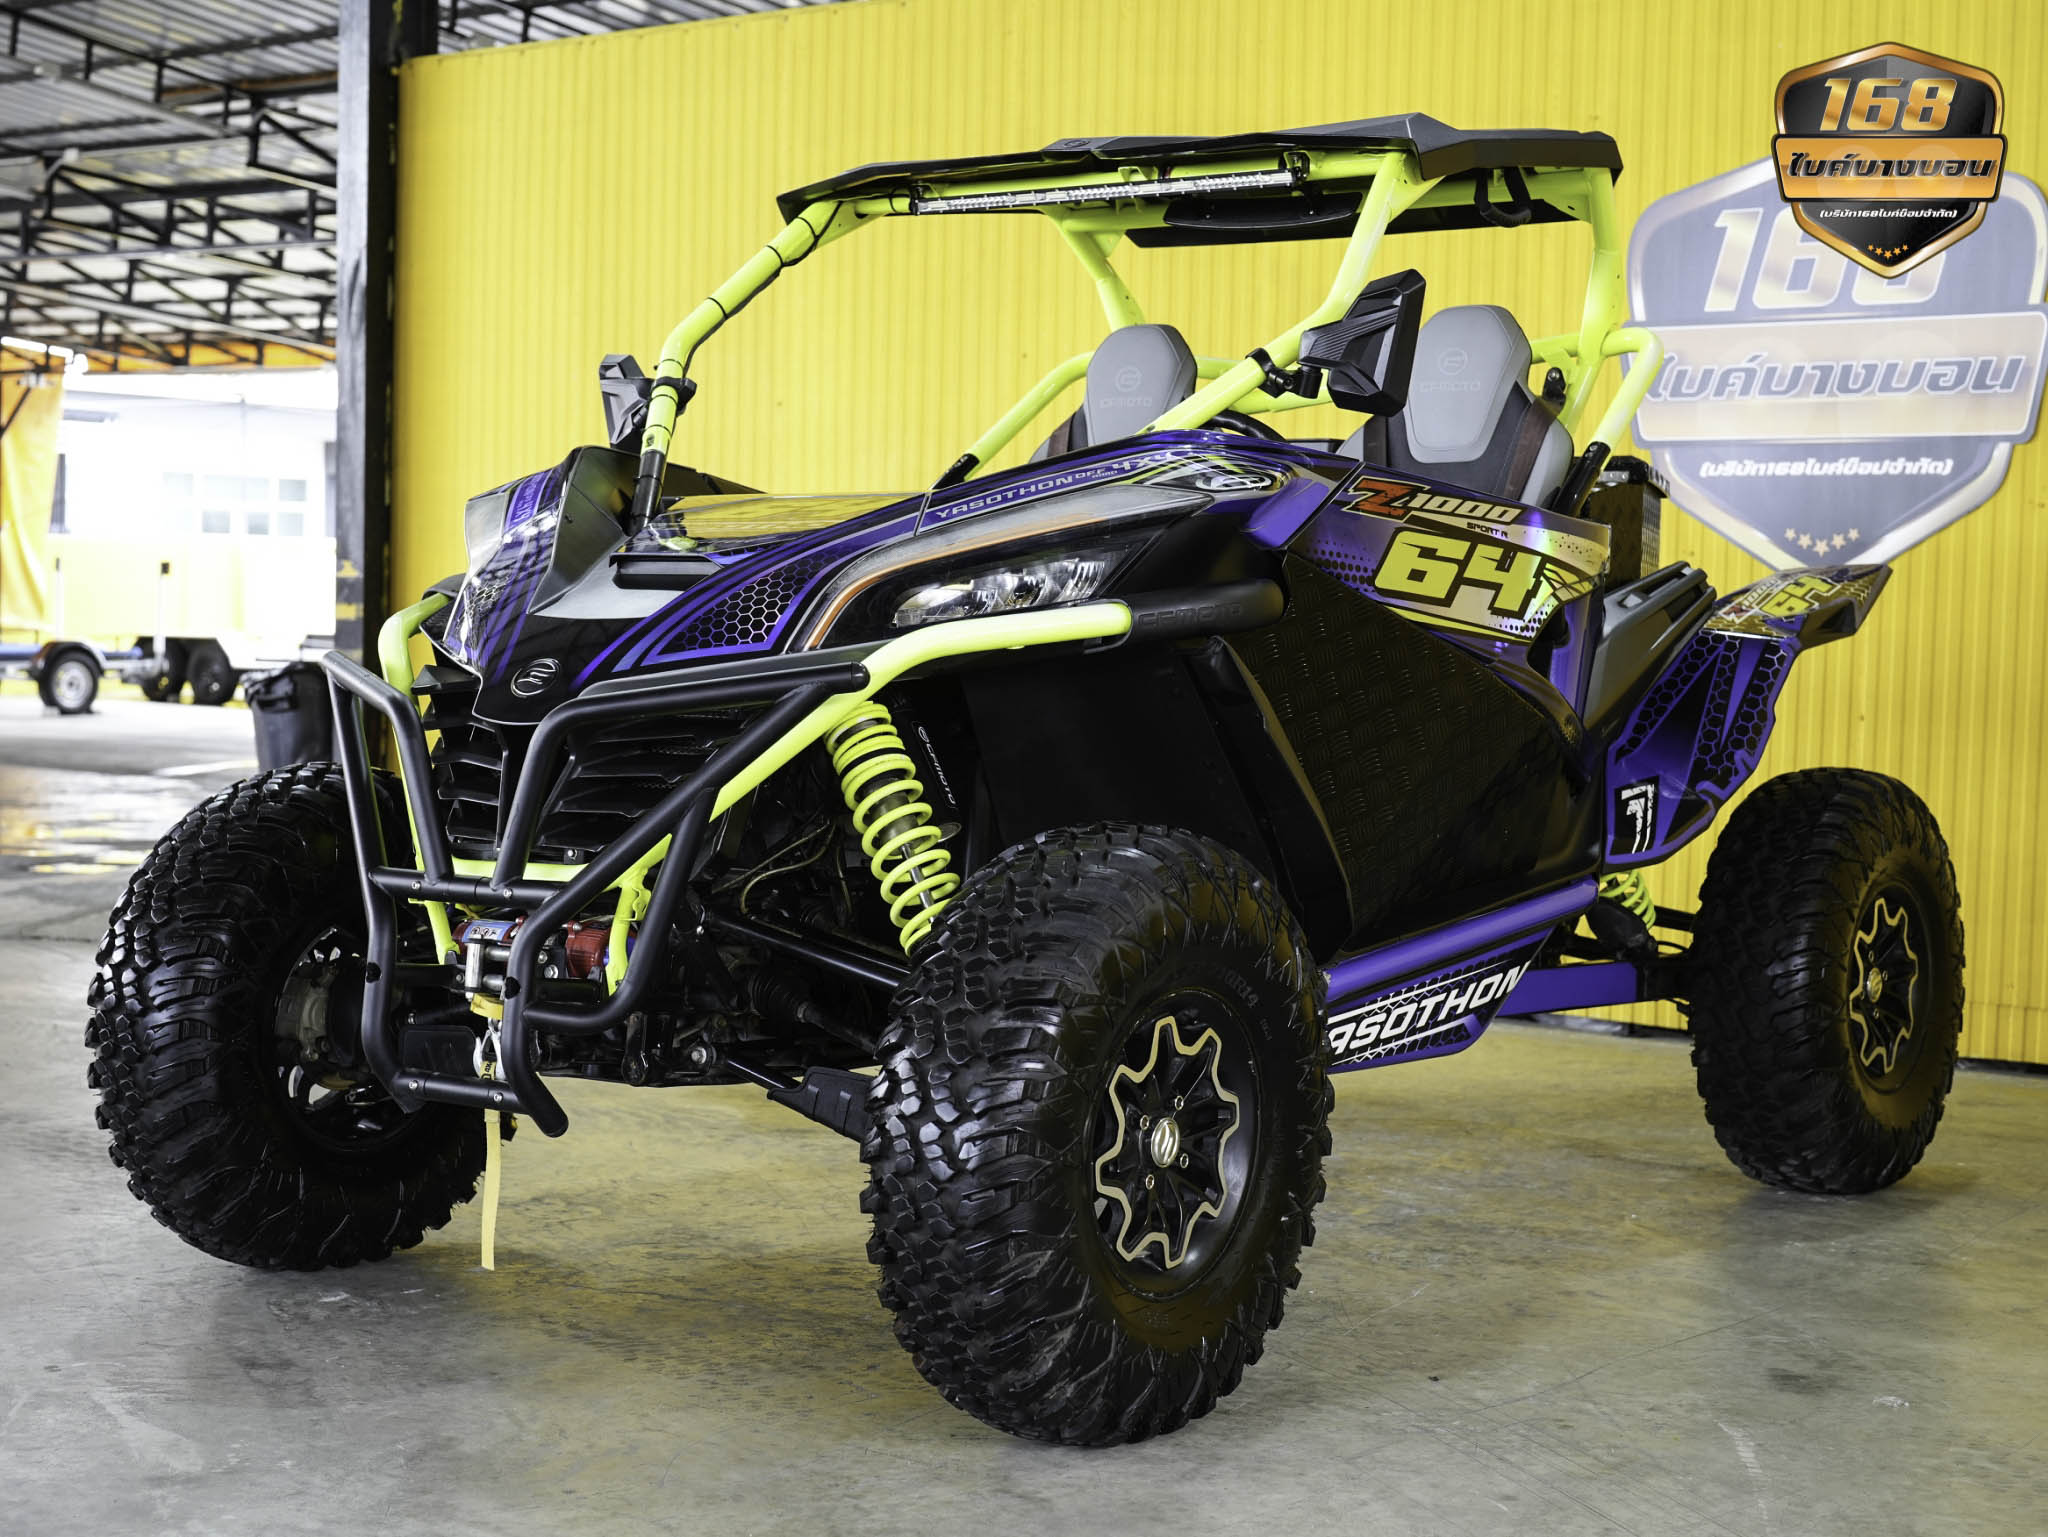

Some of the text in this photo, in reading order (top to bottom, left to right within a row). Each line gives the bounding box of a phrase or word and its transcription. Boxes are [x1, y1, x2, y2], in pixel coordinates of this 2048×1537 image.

[936, 476, 1074, 519] YASOTHON
[1466, 522, 1500, 535] SPORT
[1374, 530, 1542, 611] 64
[1760, 575, 1834, 617] 64
